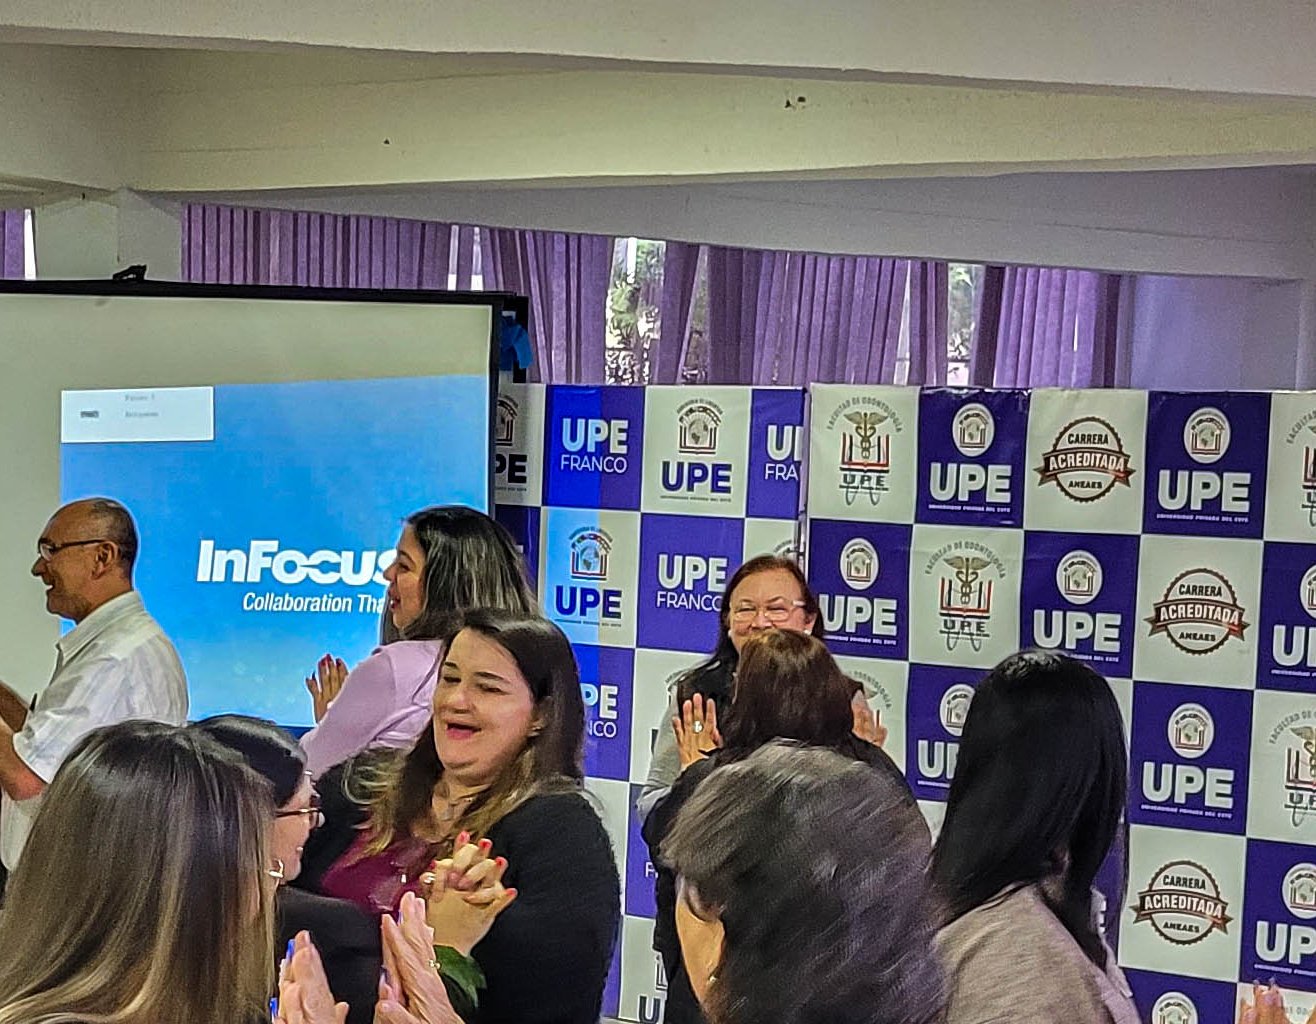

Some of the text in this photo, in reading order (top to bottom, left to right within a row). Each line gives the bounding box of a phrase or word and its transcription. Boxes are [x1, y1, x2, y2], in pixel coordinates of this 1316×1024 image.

[562, 418, 628, 454] UPE
[1068, 433, 1109, 445] CARRERA
[560, 455, 627, 473] FRANCO
[1049, 452, 1126, 471] ACREDITADA
[661, 461, 732, 494] UPE
[764, 464, 799, 481] FRA
[843, 474, 885, 486] UPE
[930, 462, 1012, 503] UPE
[1068, 480, 1103, 490] ANEAES
[1158, 470, 1251, 513] UPE
[658, 554, 728, 593] UPE
[1178, 584, 1223, 597] CARRERA
[243, 592, 385, 613] Collaboration Tha
[555, 585, 622, 619] UPE
[819, 594, 897, 636] UPE
[1159, 604, 1240, 624] ACREDITADA
[943, 619, 986, 633] UPE
[1033, 609, 1122, 653] UPE
[1178, 632, 1216, 642] ANEAES
[580, 683, 618, 720] PE
[1142, 761, 1234, 809] UPE
[1162, 874, 1206, 890] CARRERA
[1144, 894, 1223, 919] ACREDITADA
[1162, 922, 1200, 933] ANEAES
